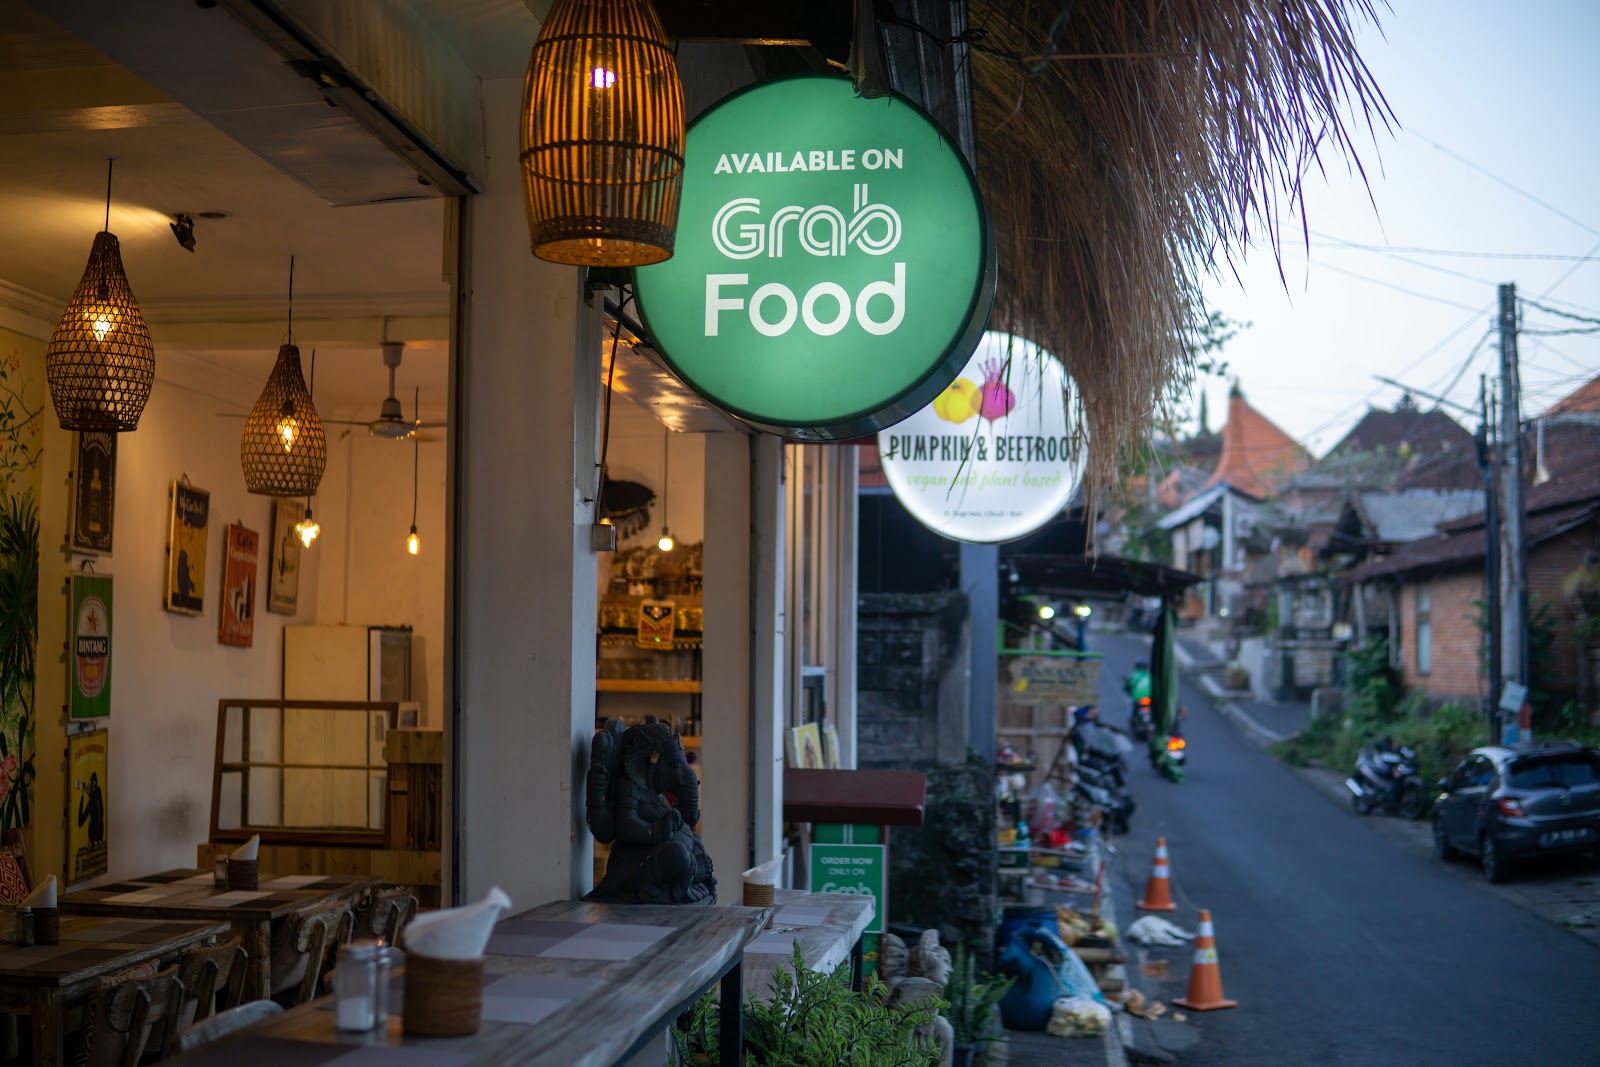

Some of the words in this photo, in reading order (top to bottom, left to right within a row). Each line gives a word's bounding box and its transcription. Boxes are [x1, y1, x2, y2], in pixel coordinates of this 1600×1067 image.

[714, 150, 855, 174] AVAILABLE
[861, 148, 903, 170] ON
[711, 183, 902, 260] Grab
[704, 262, 906, 337] Food
[889, 435, 970, 462] PUMPKIN
[977, 435, 988, 462] &
[995, 435, 1081, 462] BEETROOT
[906, 473, 947, 492] vegan
[951, 471, 978, 487] and
[979, 471, 1019, 492] plant
[1022, 469, 1061, 488] based
[78, 639, 107, 654] BINTANG
[821, 857, 850, 865] ORDER
[852, 857, 874, 865] NOW
[828, 867, 850, 876] ONLY
[851, 867, 866, 876] ON
